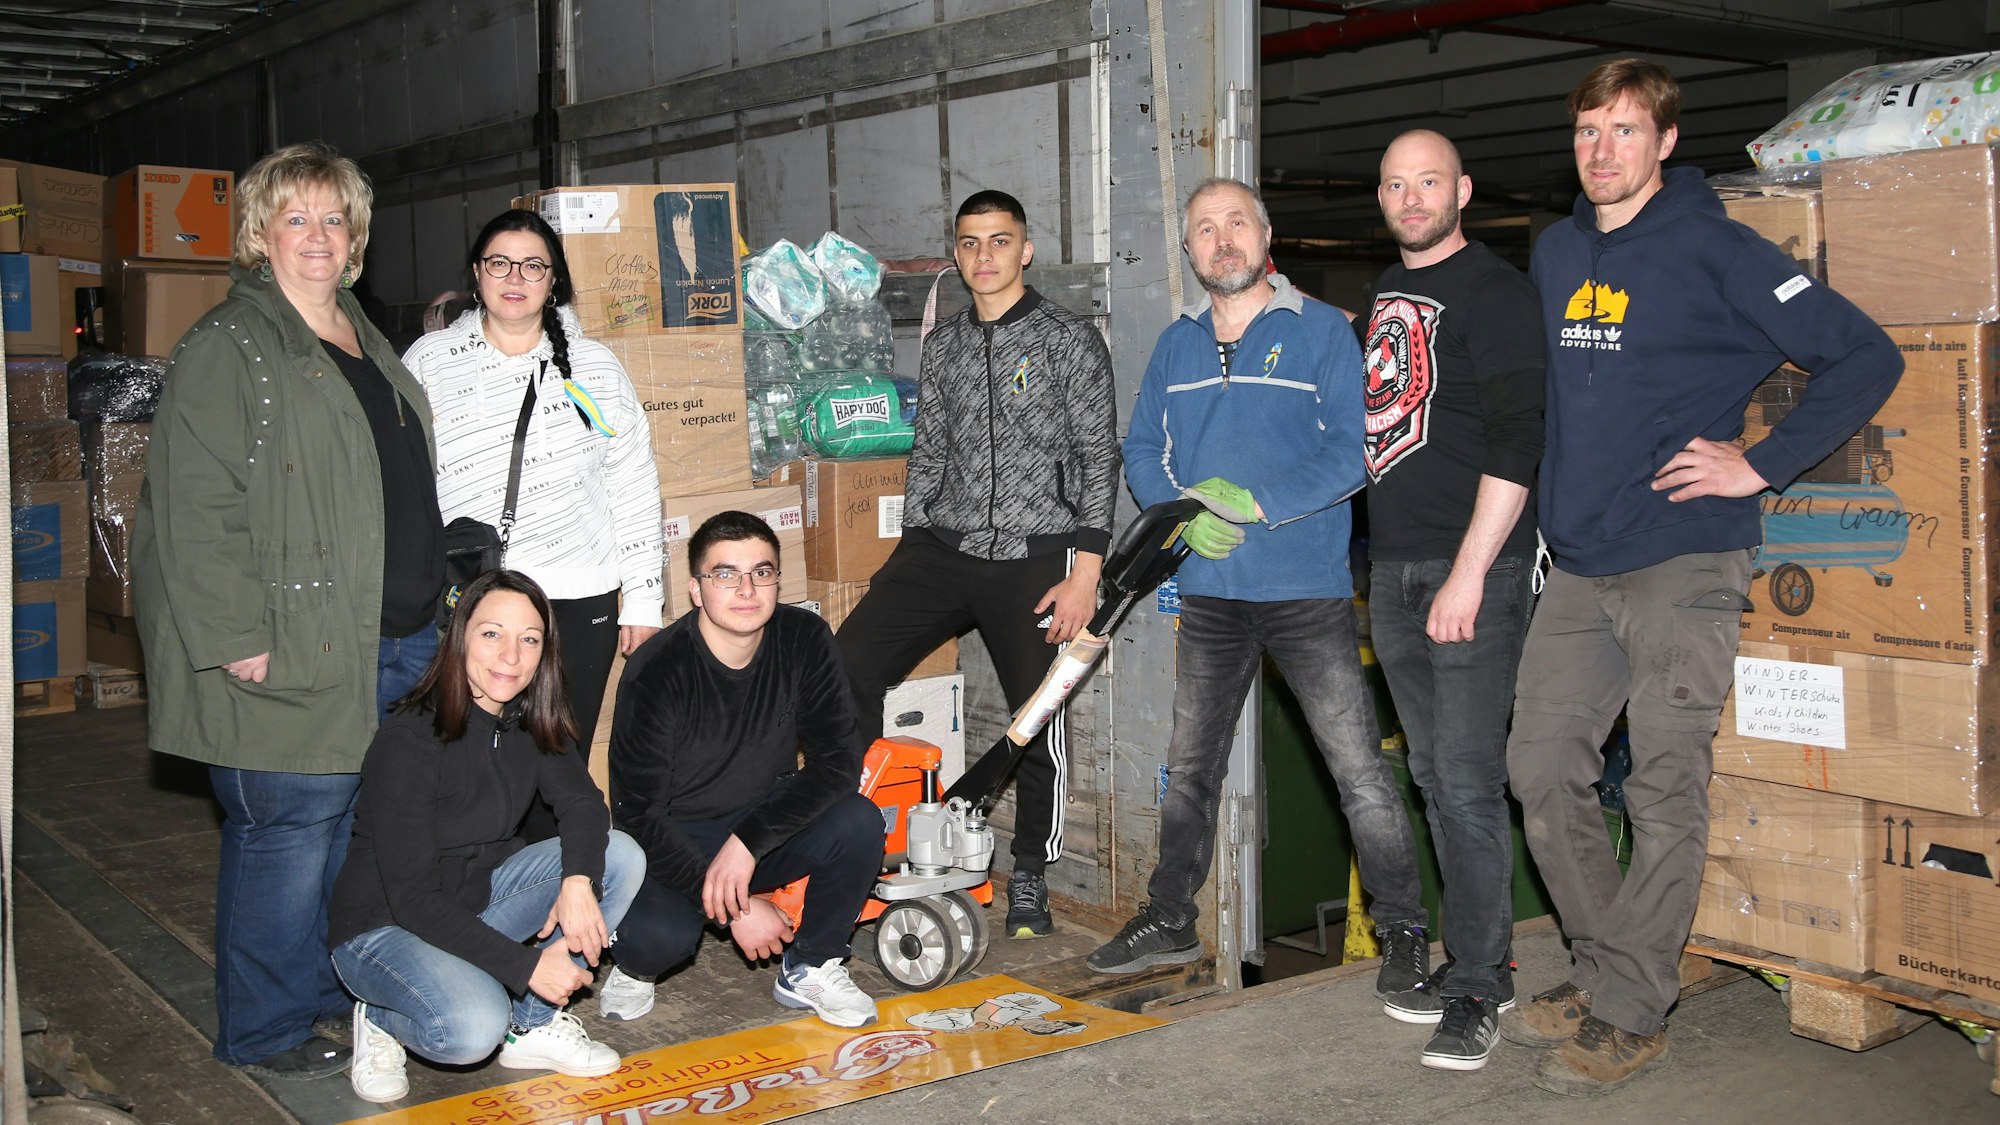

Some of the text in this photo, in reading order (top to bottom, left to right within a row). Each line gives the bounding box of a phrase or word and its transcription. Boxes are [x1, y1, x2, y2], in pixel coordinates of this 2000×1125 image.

[144, 172, 181, 184] OBI
[694, 193, 725, 201] Advanced
[605, 254, 658, 281] Clothes
[705, 278, 731, 287] Lunch
[690, 296, 729, 310] TORK
[1378, 302, 1418, 329] LOVE MUSIC
[1561, 324, 1602, 341] adidas
[1560, 340, 1622, 351] ADVENTURE
[1929, 341, 1942, 351] de
[1945, 341, 1968, 351] aire
[481, 362, 501, 373] DKNY
[1398, 334, 1408, 391] FOUNDATION
[1957, 358, 1967, 381] Luft
[642, 398, 704, 412] Gutes gut
[1375, 391, 1393, 407] STAND
[866, 399, 886, 416] DOG
[451, 413, 469, 424] DKNY
[681, 411, 737, 427] verpackt!
[1367, 404, 1404, 432] RACISM
[1957, 384, 1969, 450] Kompressor
[582, 444, 597, 455] DKNY
[523, 451, 553, 466] DKY
[1960, 457, 1970, 474] Air
[454, 463, 475, 476] DKNY
[528, 481, 550, 493] DKNY
[1960, 475, 1971, 541] Compressor
[779, 512, 800, 520] HAUS
[780, 518, 800, 526] HAIR
[546, 538, 564, 549] DKNY
[620, 540, 647, 555] DKNY
[592, 615, 609, 625] DKNY
[1963, 619, 1973, 635] air
[1772, 622, 1975, 651] Compresseur air Compressore d'aria
[1747, 721, 1780, 733] Winter
[471, 1080, 571, 1110] 1925
[725, 1074, 913, 1124] Konditorei
